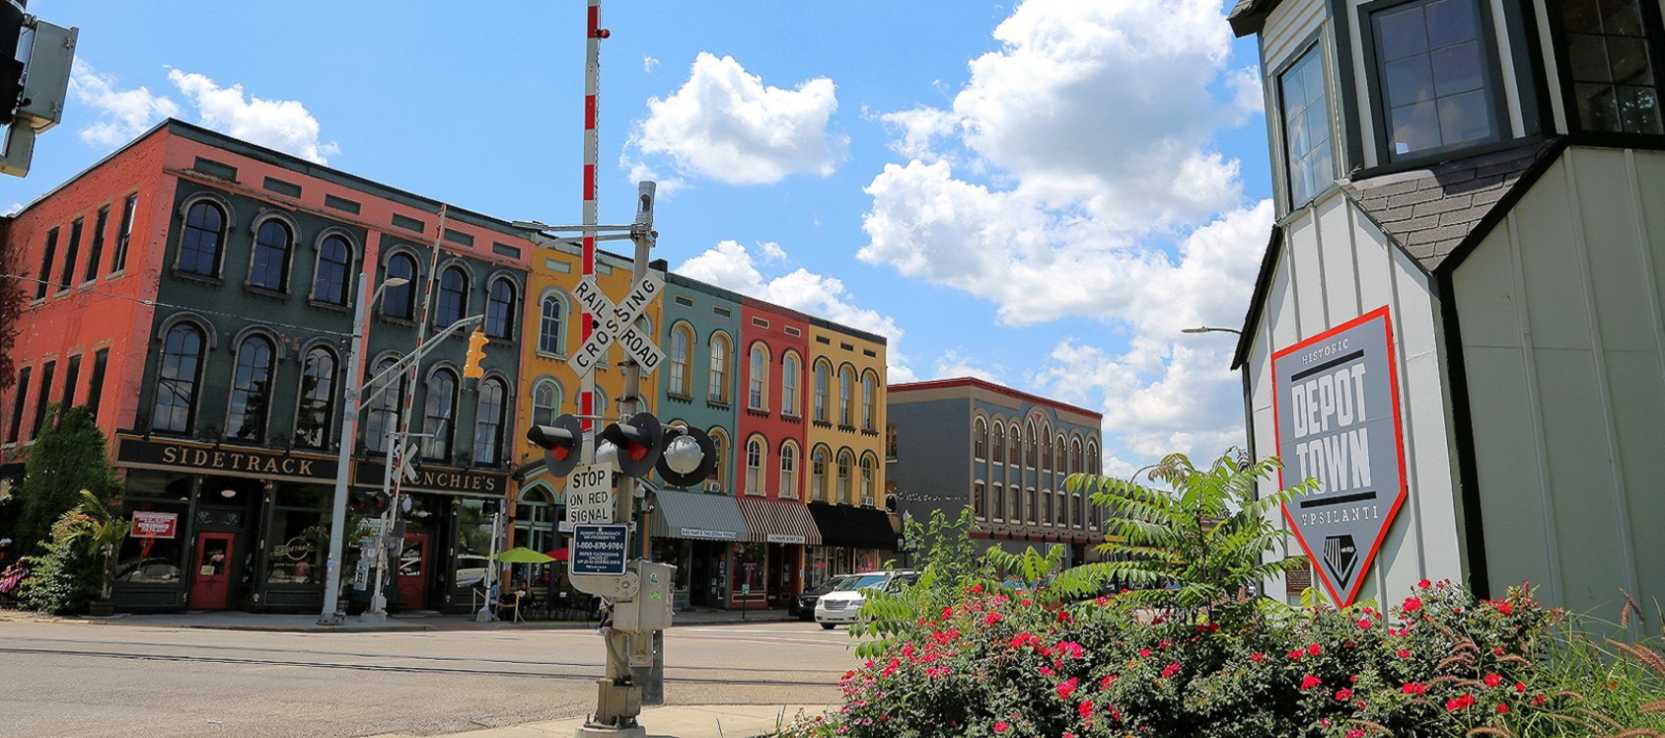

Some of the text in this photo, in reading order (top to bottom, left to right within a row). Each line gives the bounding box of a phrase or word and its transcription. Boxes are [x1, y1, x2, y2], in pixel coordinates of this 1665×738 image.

[576, 281, 658, 368] RAIL ROAD
[1302, 338, 1349, 365] HISTORIC
[1291, 363, 1367, 439] DEPOT
[162, 447, 313, 476] SIDETRACK
[1296, 428, 1372, 496] TOWN
[573, 470, 606, 489] STOP
[569, 491, 608, 507] ON RED
[570, 509, 608, 523] SIGNAL
[1301, 506, 1378, 526] YPSILANTI
